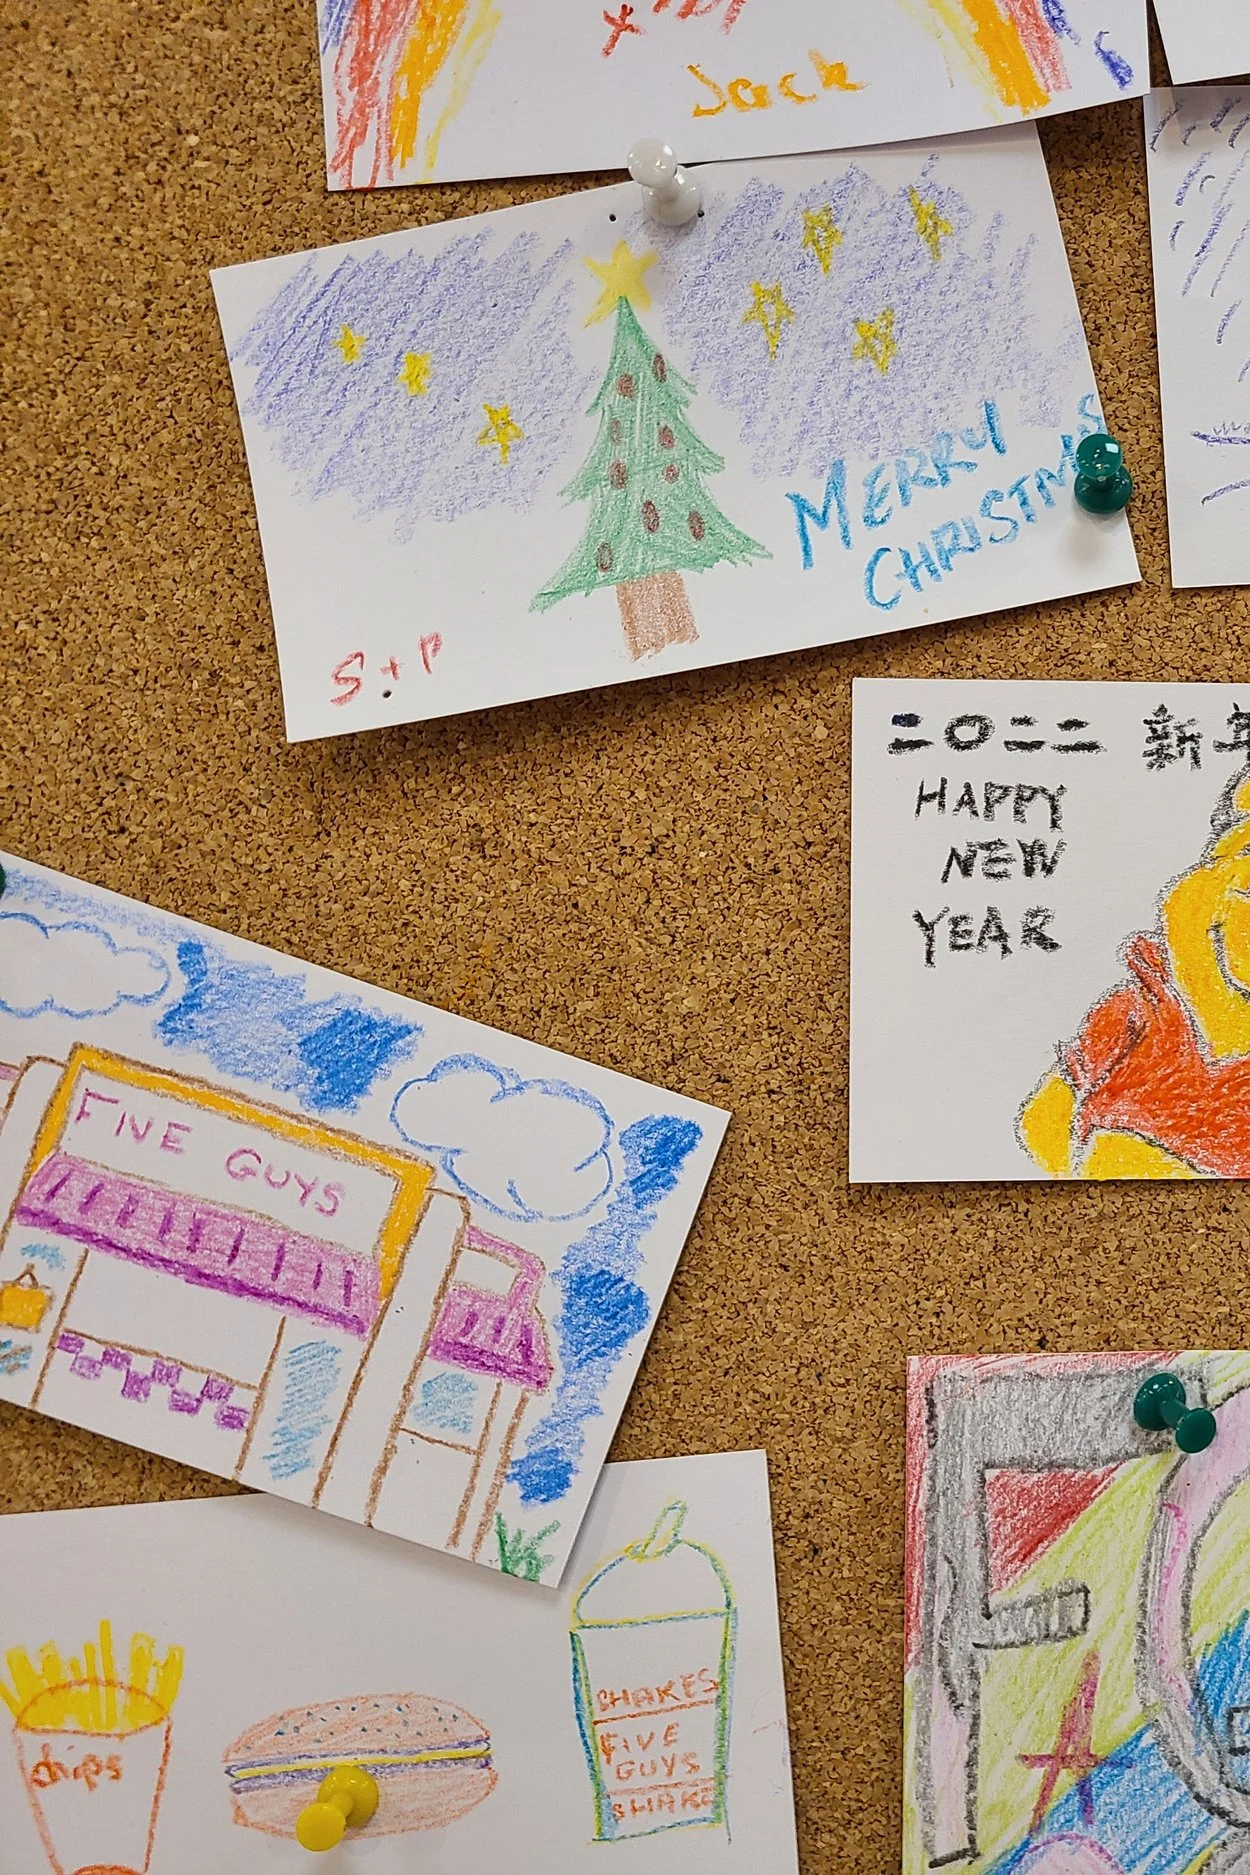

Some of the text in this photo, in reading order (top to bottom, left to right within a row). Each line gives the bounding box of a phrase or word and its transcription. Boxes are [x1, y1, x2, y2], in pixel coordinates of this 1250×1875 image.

[687, 49, 866, 117] Jack
[914, 776, 1067, 833] HAPPY
[940, 837, 1067, 884] NEW
[912, 904, 1062, 968] YEAR
[74, 1087, 346, 1216] FIVE GUYS
[596, 1667, 721, 1713] SHAKES
[30, 1742, 123, 1792] chips
[615, 1752, 702, 1782] GUYS
